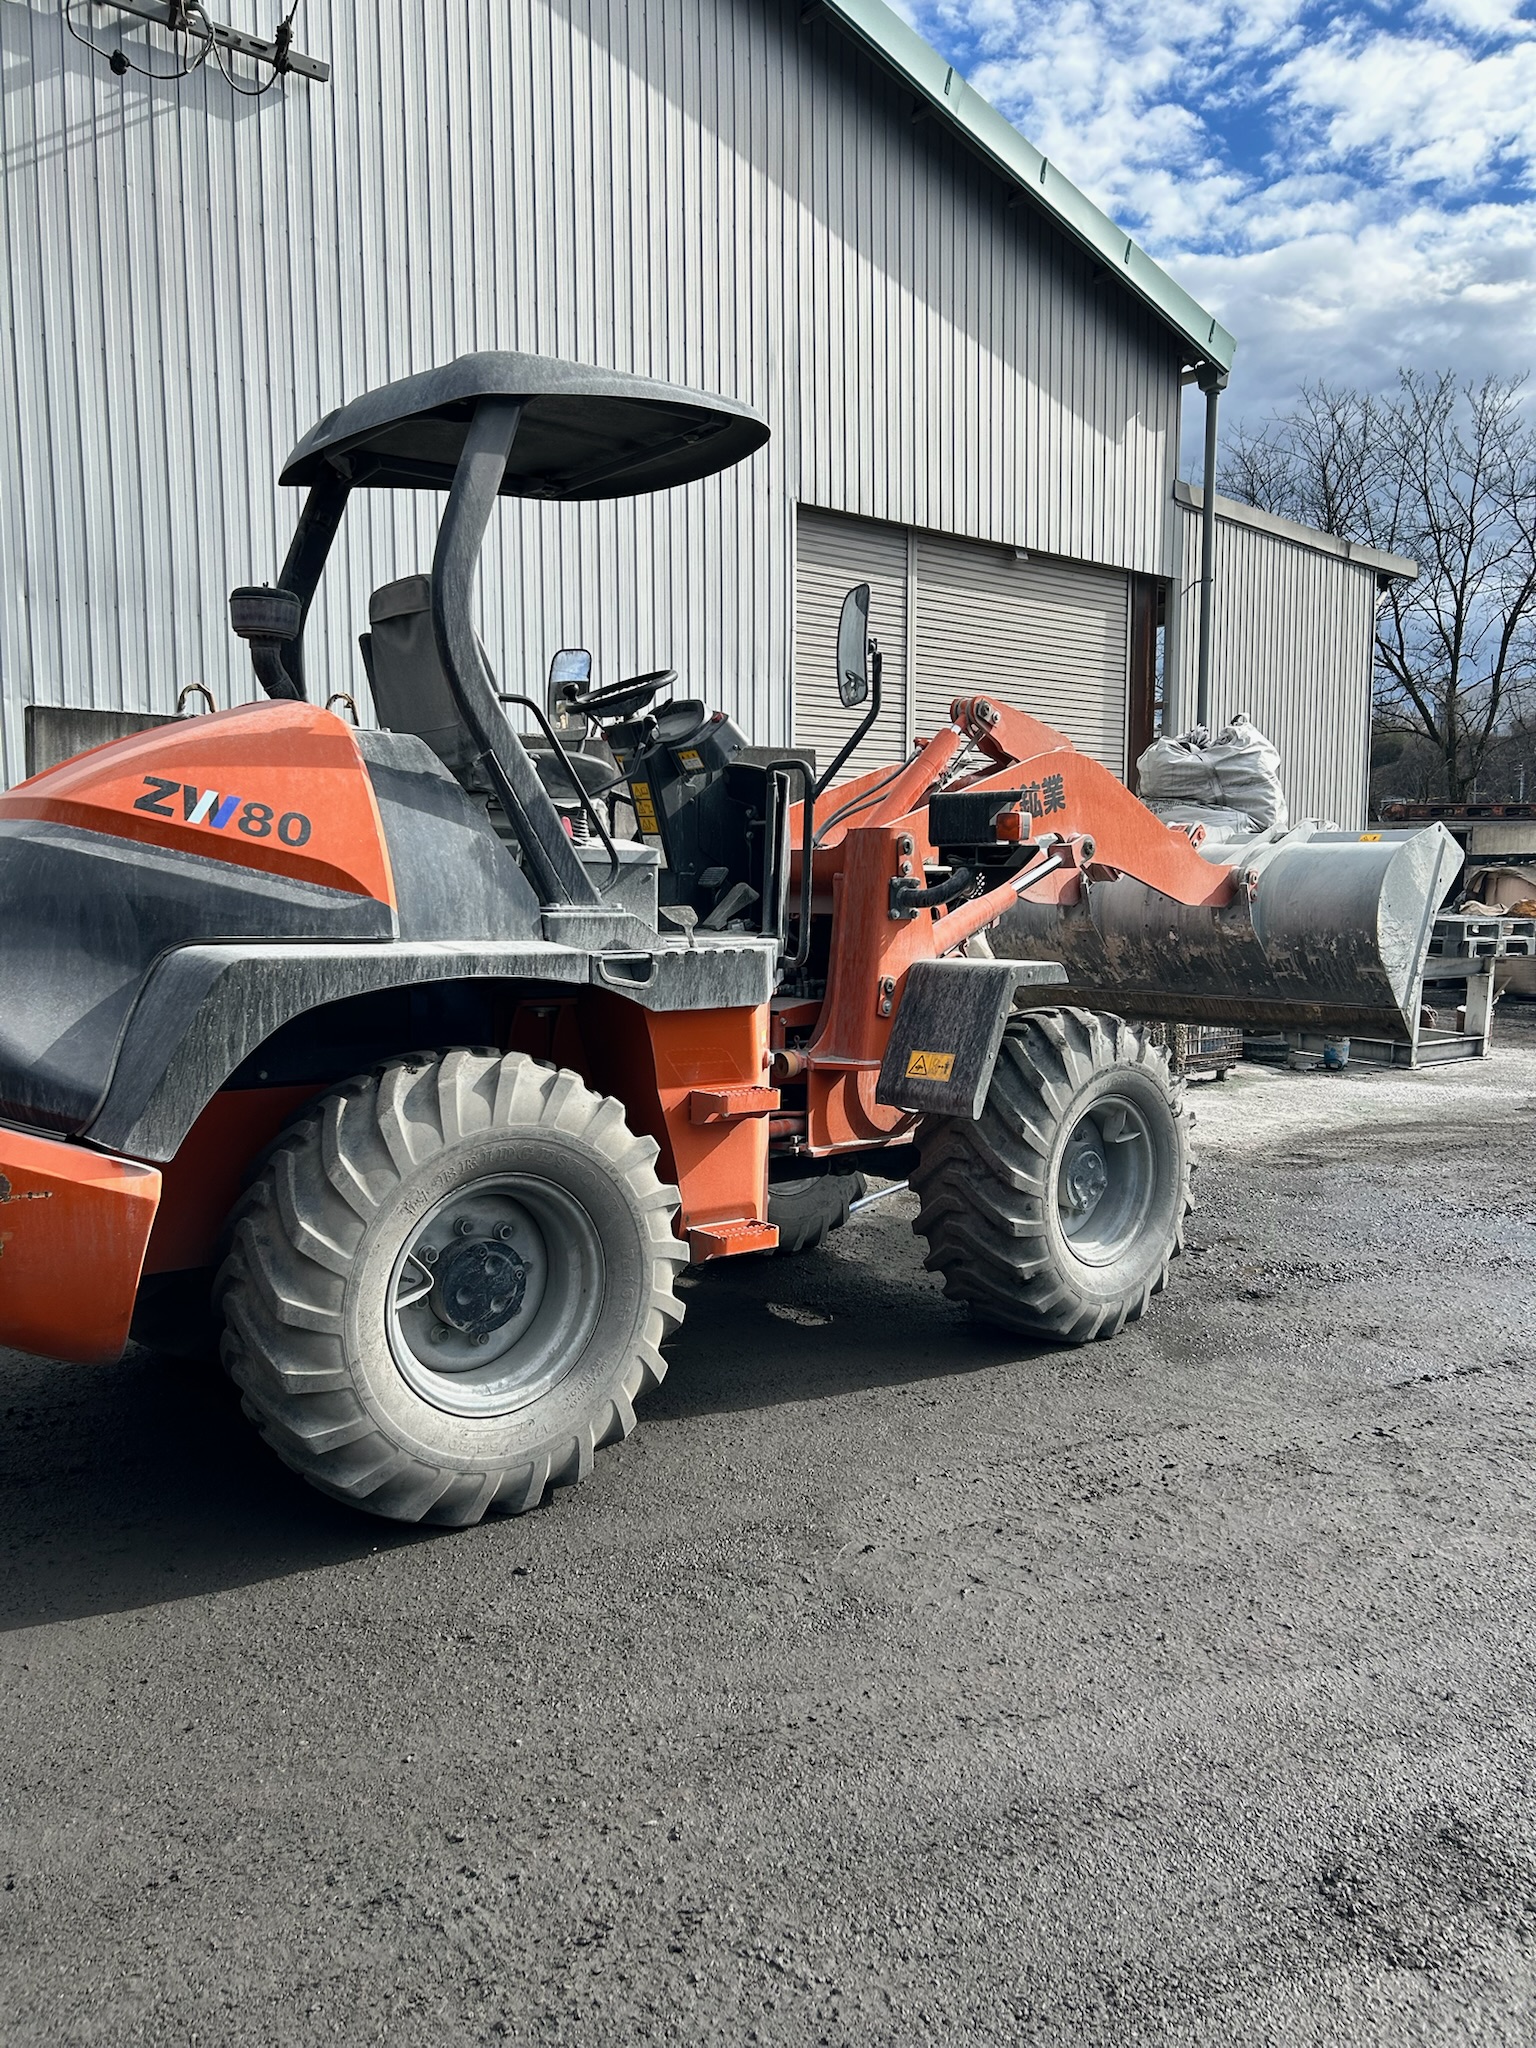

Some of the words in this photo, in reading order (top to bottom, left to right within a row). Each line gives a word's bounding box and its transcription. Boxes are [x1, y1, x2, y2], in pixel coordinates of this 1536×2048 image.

[133, 776, 312, 846] ZW80
[1009, 773, 1066, 818] 鉱業
[431, 1146, 623, 1218] BRIDGESTONE
